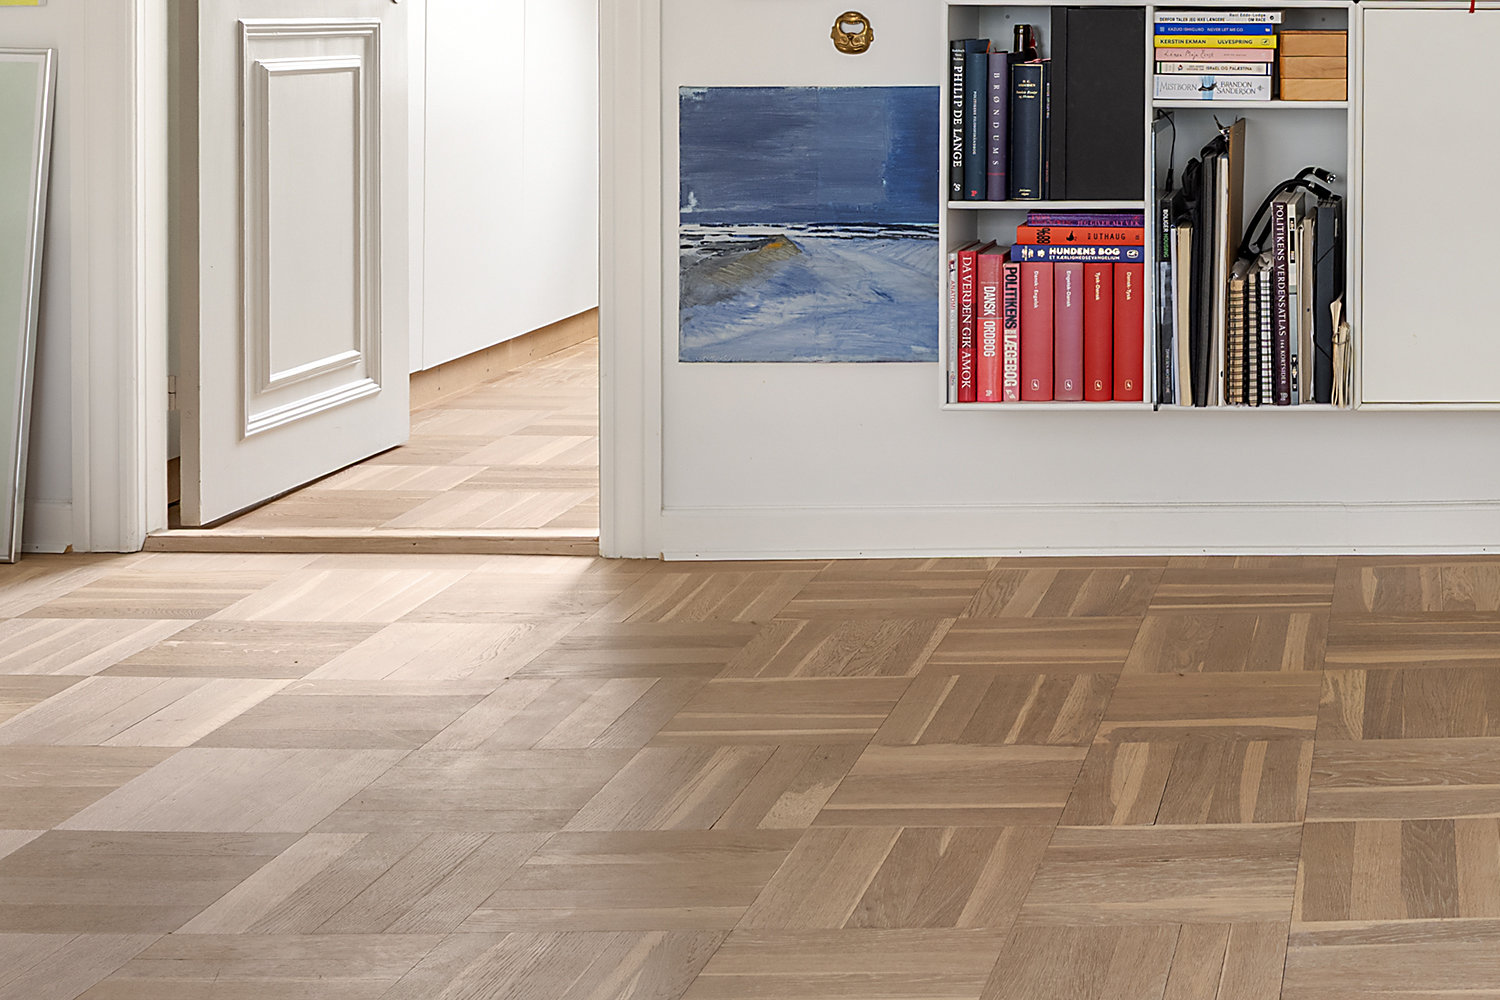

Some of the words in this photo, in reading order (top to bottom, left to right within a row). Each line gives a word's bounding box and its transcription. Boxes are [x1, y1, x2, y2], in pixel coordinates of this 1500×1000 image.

[953, 66, 962, 108] PHILIP
[953, 110, 962, 124] DE
[953, 128, 962, 168] LANGE
[1276, 205, 1286, 260] POLITIKENS
[962, 256, 972, 275] DA
[962, 276, 972, 324] VERDEN
[984, 286, 996, 316] DANSK
[1006, 266, 1017, 328] POLITIKENS
[1278, 264, 1286, 336] VERDENSATLAS
[962, 326, 972, 348] GIK
[984, 320, 996, 356] ORDBOG
[962, 350, 972, 388] AMOK
[1006, 334, 1017, 386] LÆGEBOG
